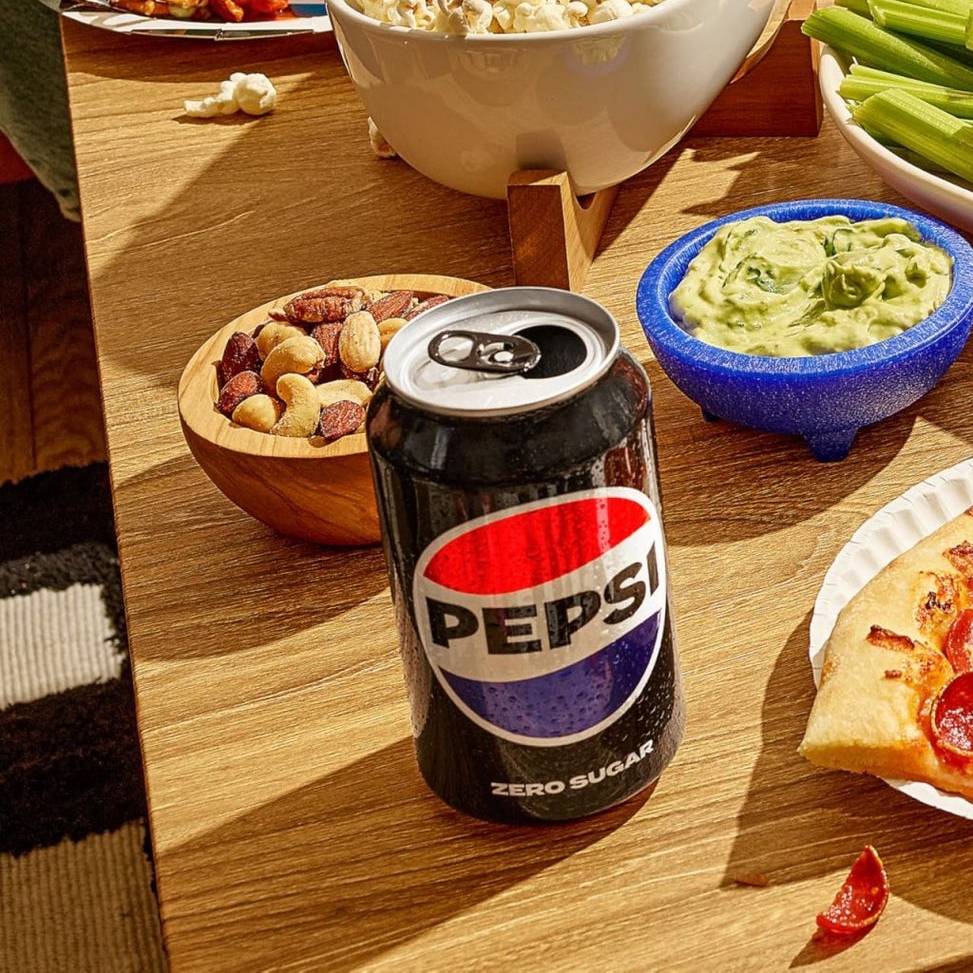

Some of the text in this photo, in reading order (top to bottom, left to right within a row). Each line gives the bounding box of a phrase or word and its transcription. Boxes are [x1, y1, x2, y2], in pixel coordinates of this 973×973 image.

[425, 540, 660, 656] PEPSI
[490, 738, 655, 797] ZERO SUGAR
